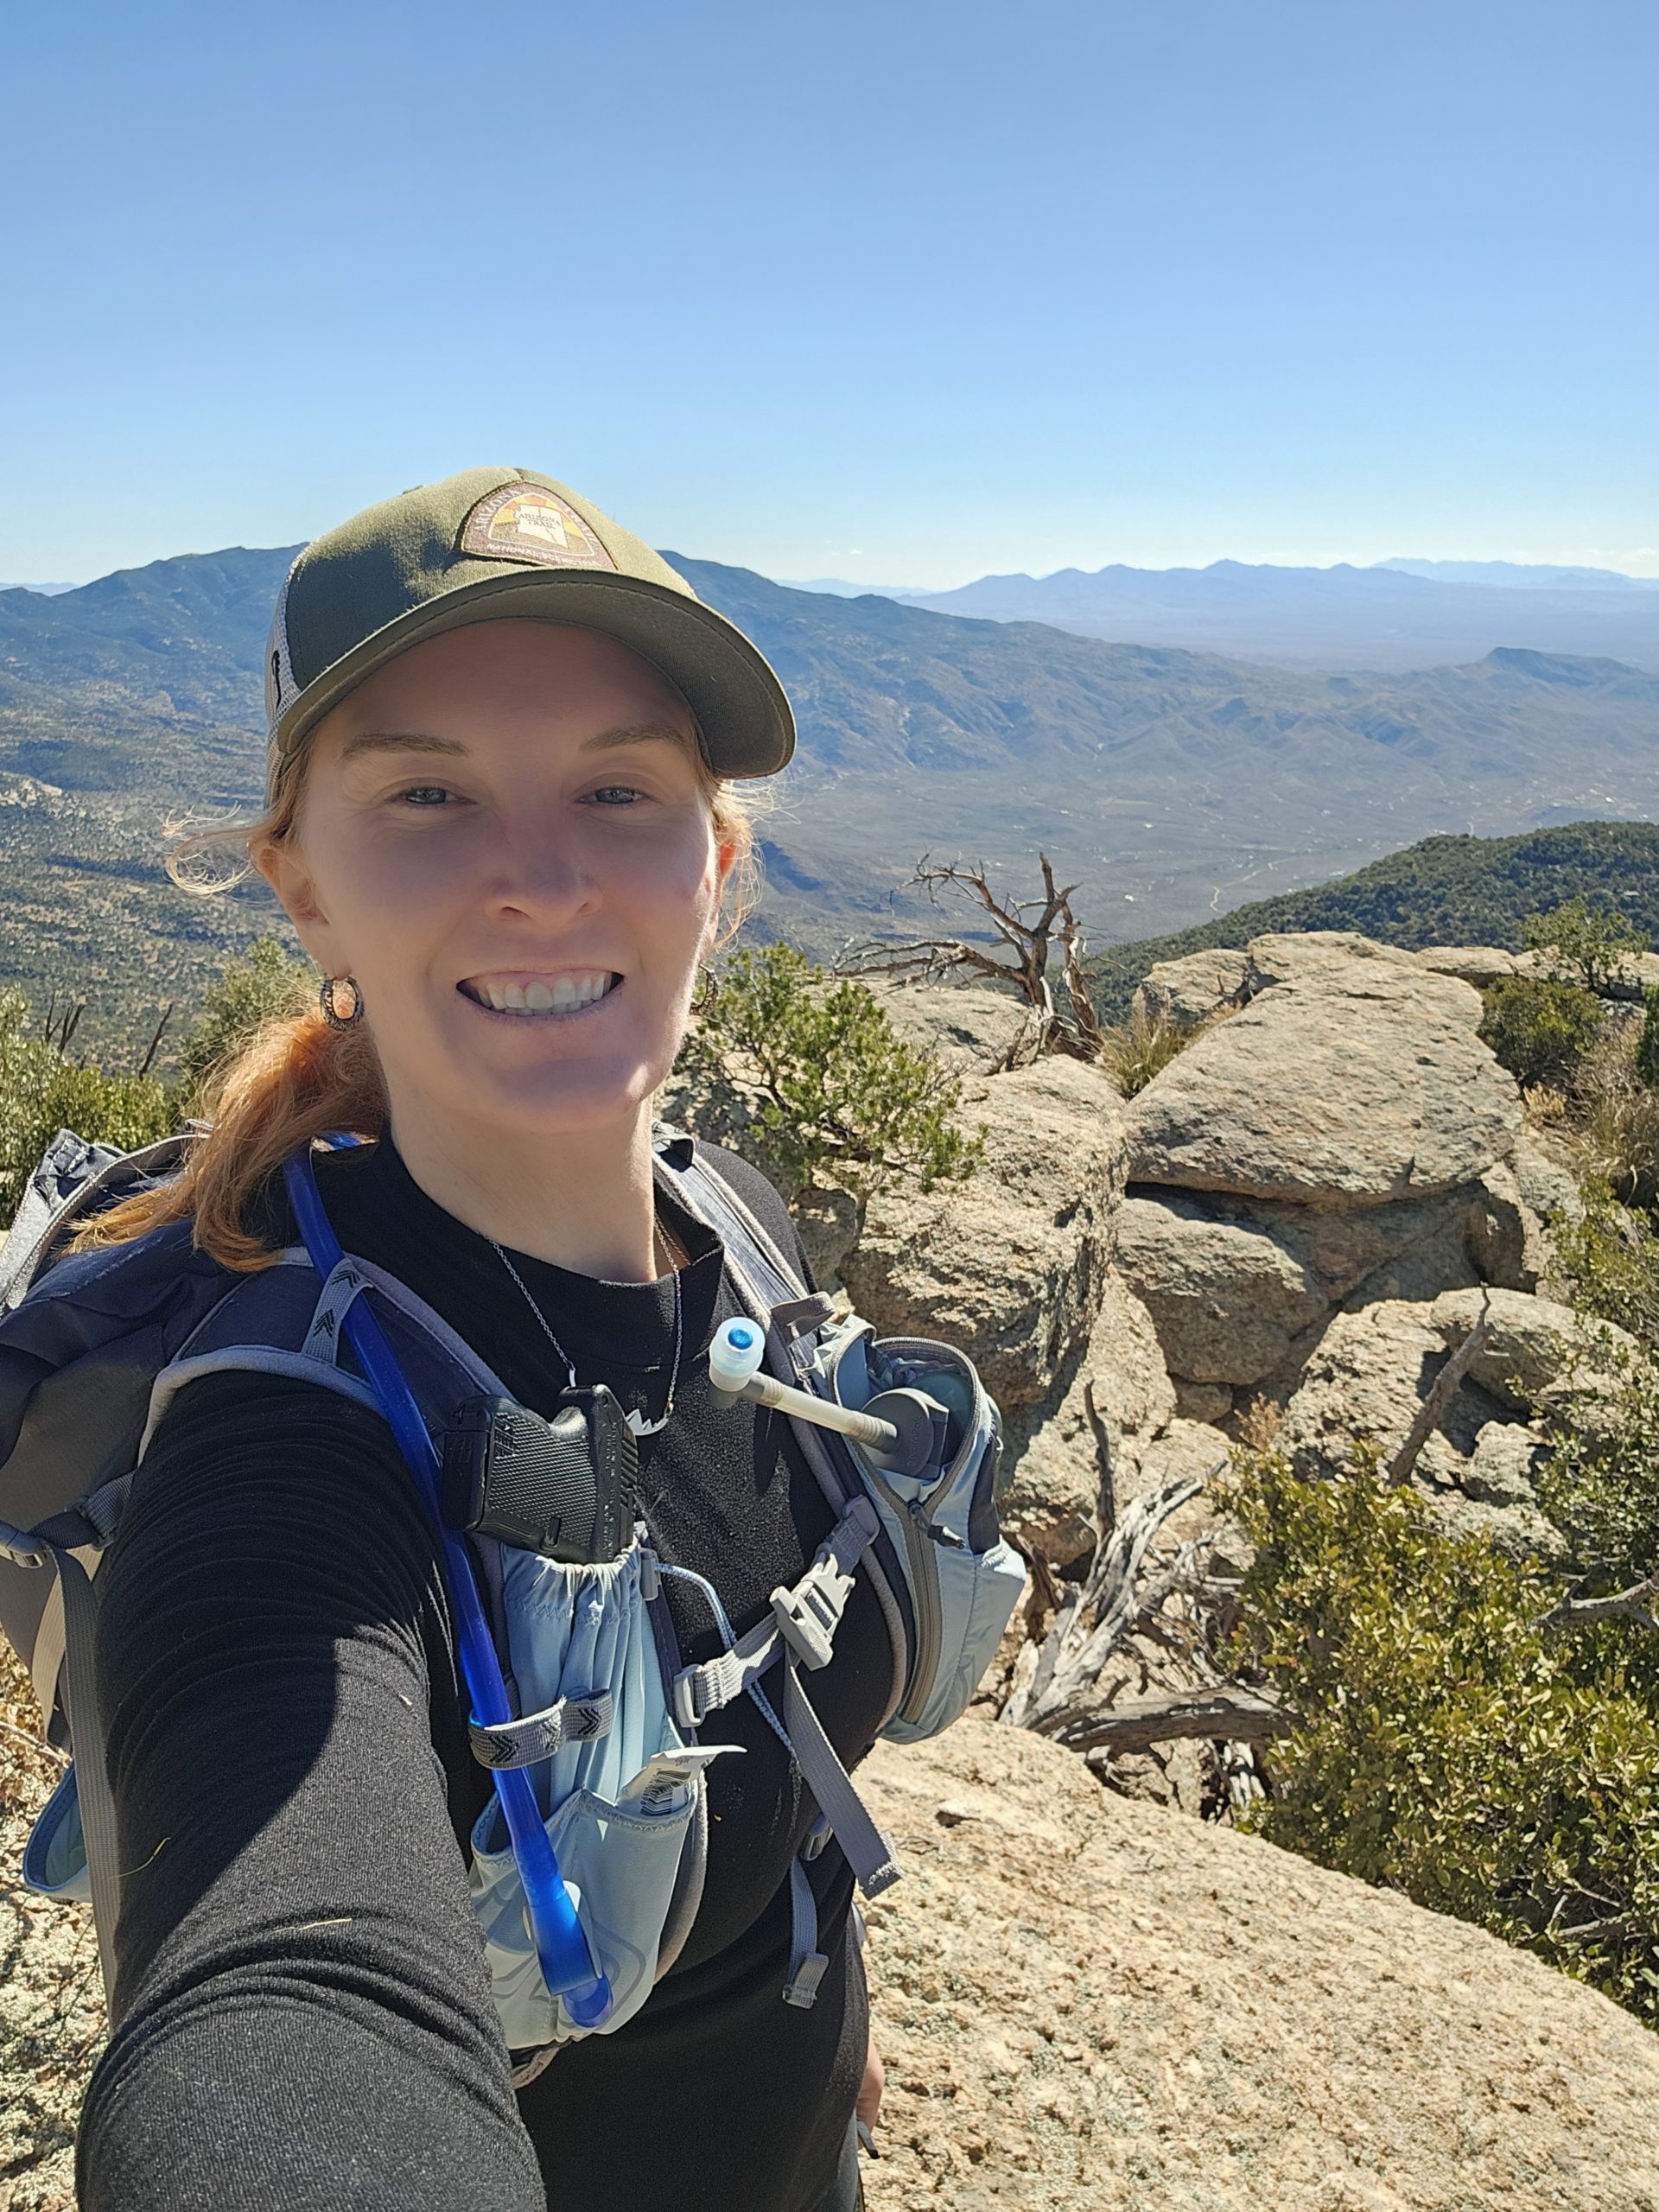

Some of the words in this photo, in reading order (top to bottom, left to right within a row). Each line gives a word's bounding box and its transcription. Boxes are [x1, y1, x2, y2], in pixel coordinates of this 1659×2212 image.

[474, 489, 522, 531] ARIZONA
[518, 513, 561, 526] ARIZONA
[527, 519, 556, 530] TRAIL
[486, 543, 540, 557] NATIONAL
